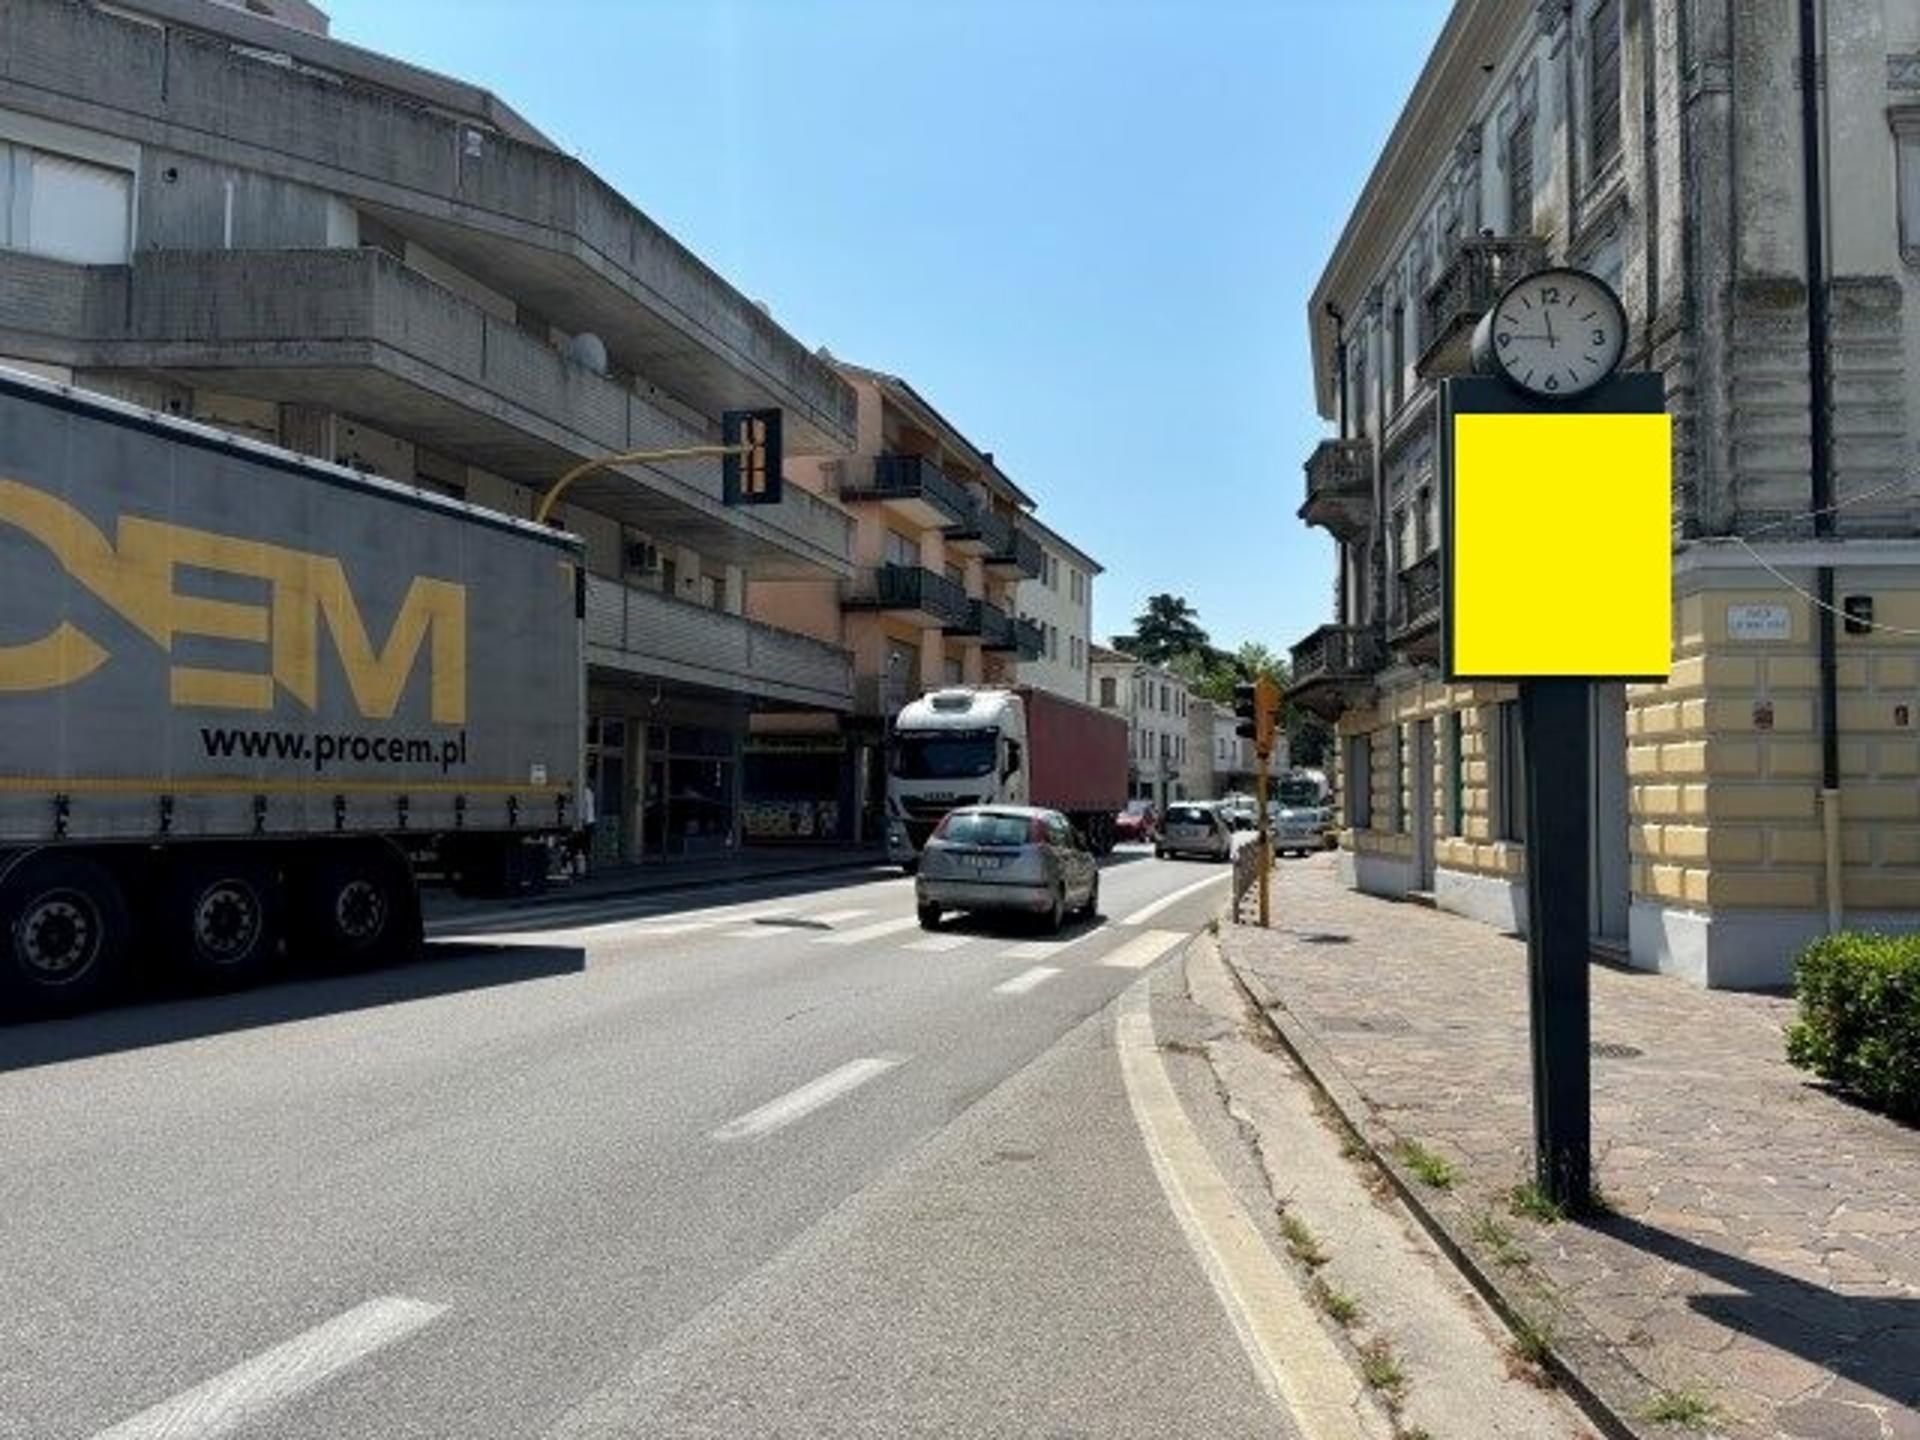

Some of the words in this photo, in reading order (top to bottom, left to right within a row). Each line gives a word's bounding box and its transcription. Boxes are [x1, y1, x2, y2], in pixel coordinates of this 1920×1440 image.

[1541, 287, 1560, 304] 12
[1497, 332, 1511, 348] 9
[1592, 329, 1606, 346] 3
[1544, 373, 1559, 391] 6
[200, 727, 467, 774] www.procem.pl
